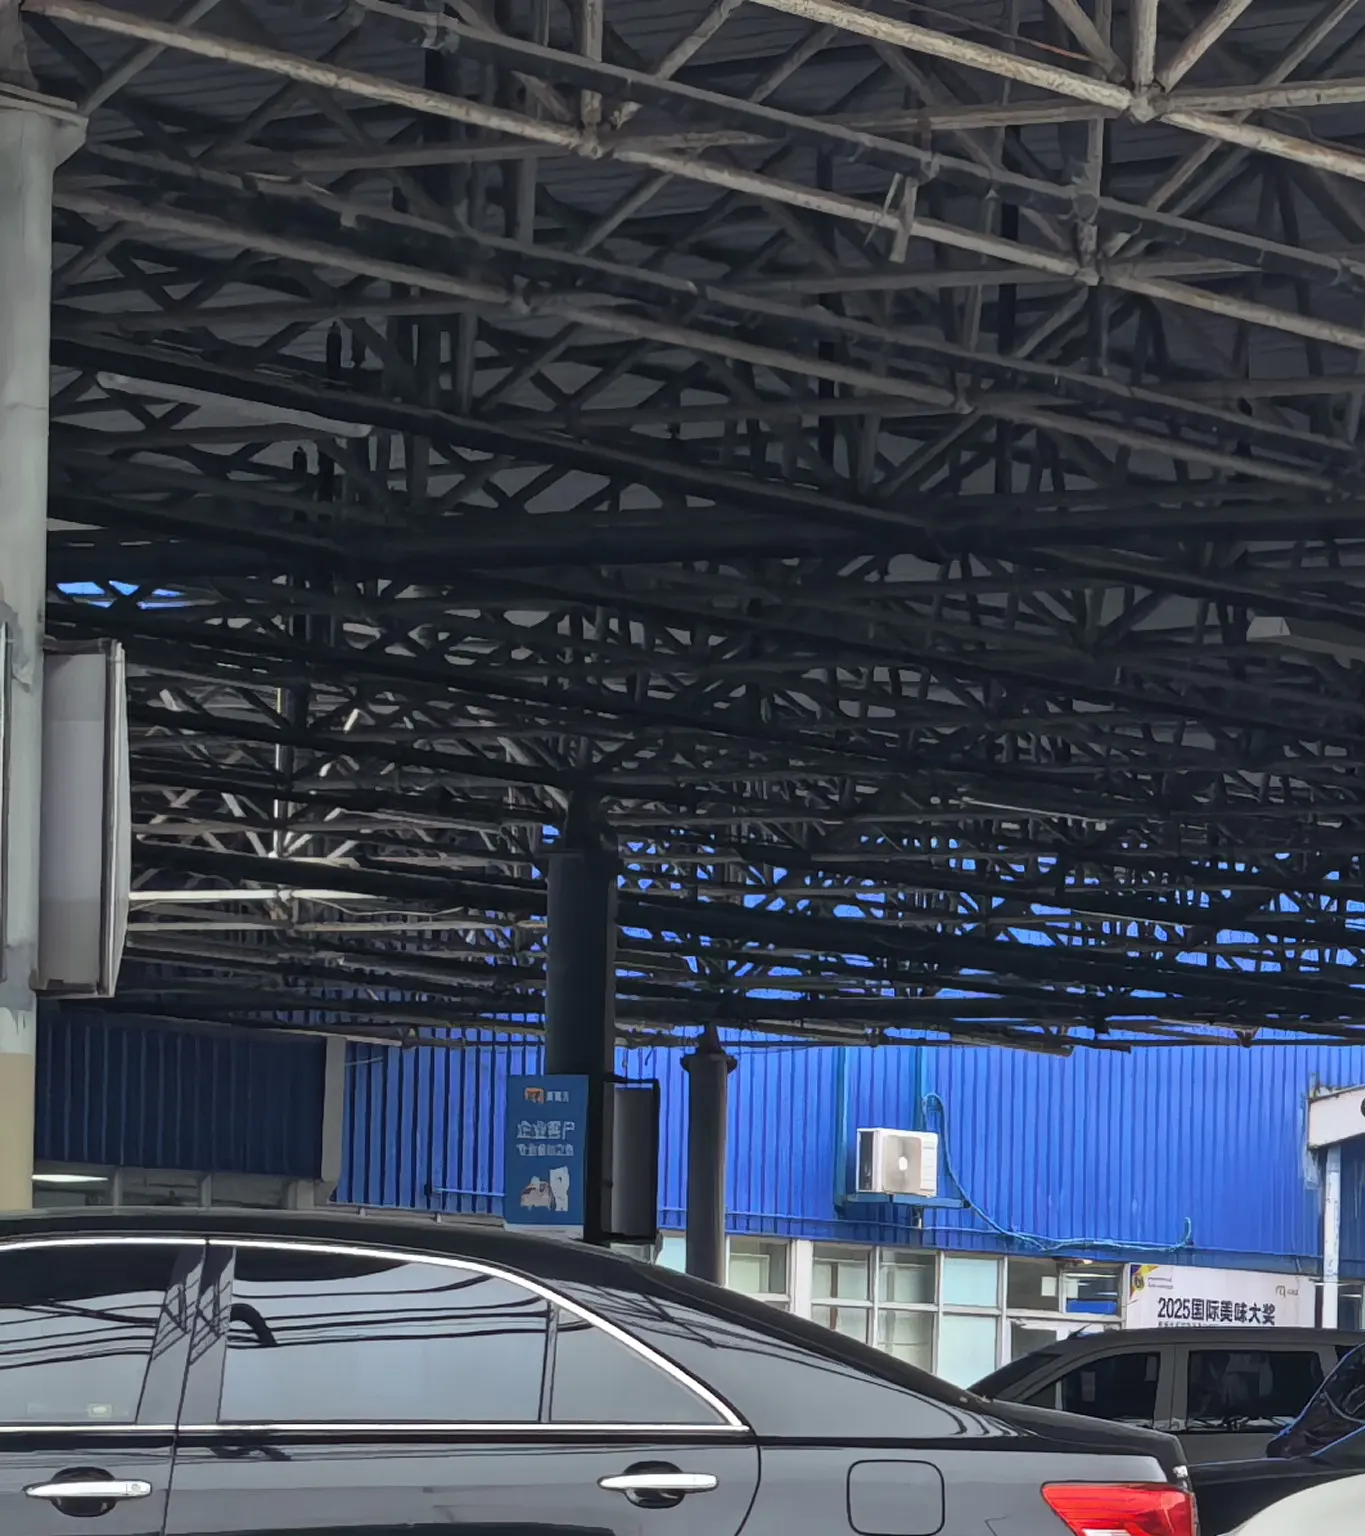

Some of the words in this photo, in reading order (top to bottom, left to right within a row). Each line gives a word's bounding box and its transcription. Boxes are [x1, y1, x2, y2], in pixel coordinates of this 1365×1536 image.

[1157, 1297, 1277, 1326] 2025国际美味大奖
